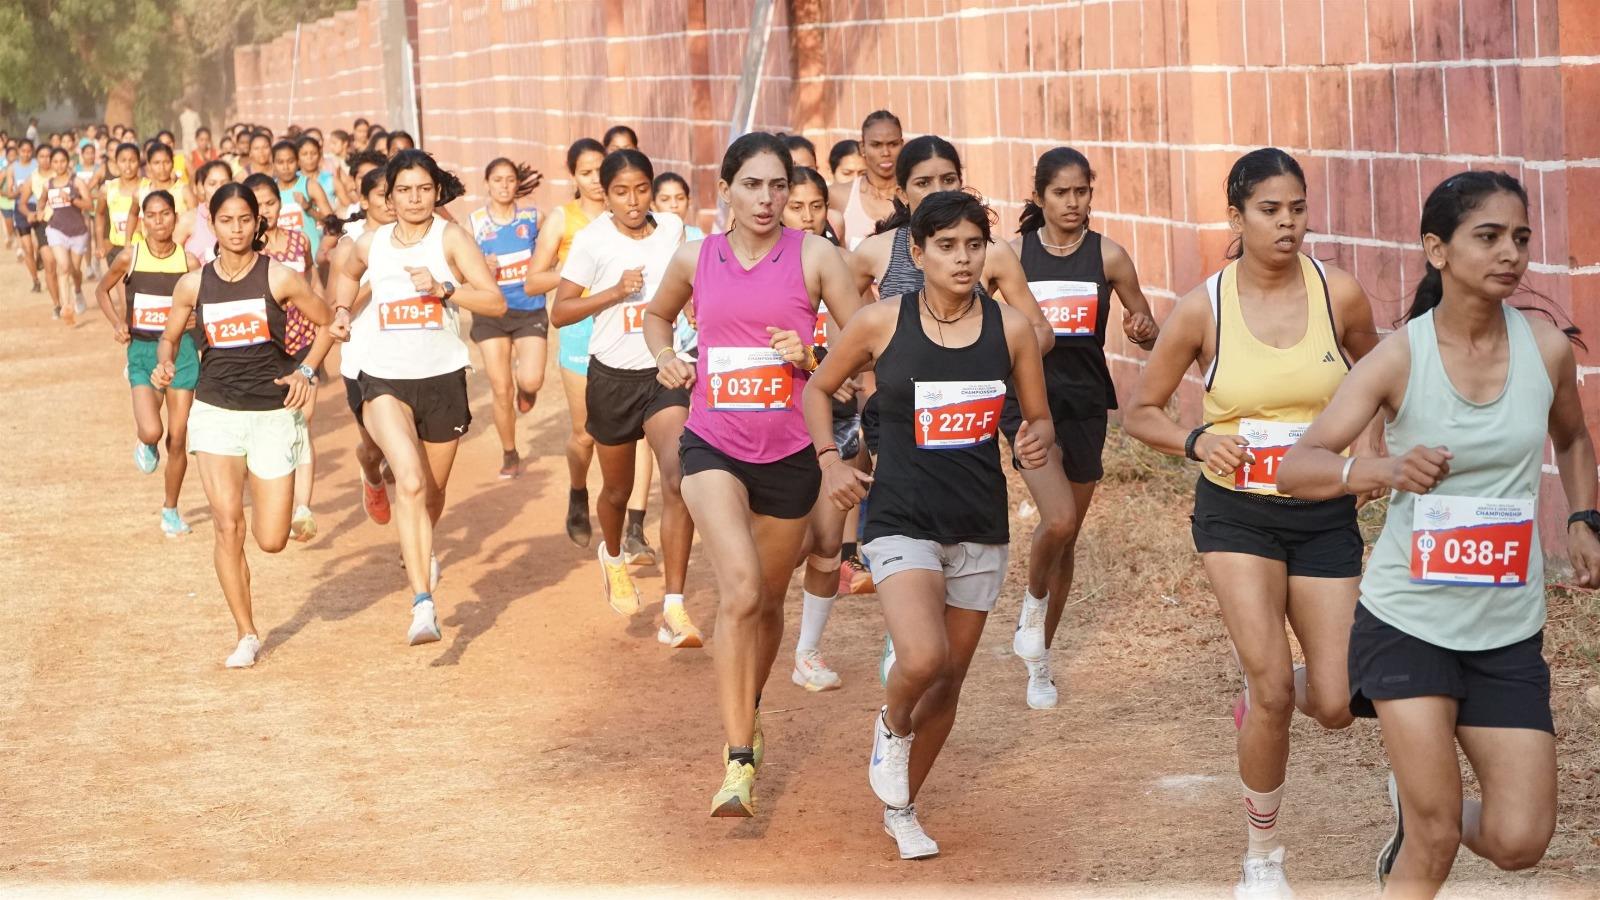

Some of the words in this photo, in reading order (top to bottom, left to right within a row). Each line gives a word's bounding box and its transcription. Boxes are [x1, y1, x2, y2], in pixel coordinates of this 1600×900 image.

[144, 311, 169, 323] 229-
[393, 304, 434, 320] 179-F
[220, 320, 260, 338] 234-F
[727, 378, 783, 396] 037-F
[921, 414, 931, 422] 10
[939, 411, 995, 432] 227-F
[1419, 538, 1433, 549] 10
[1443, 538, 1520, 566] 038-F
